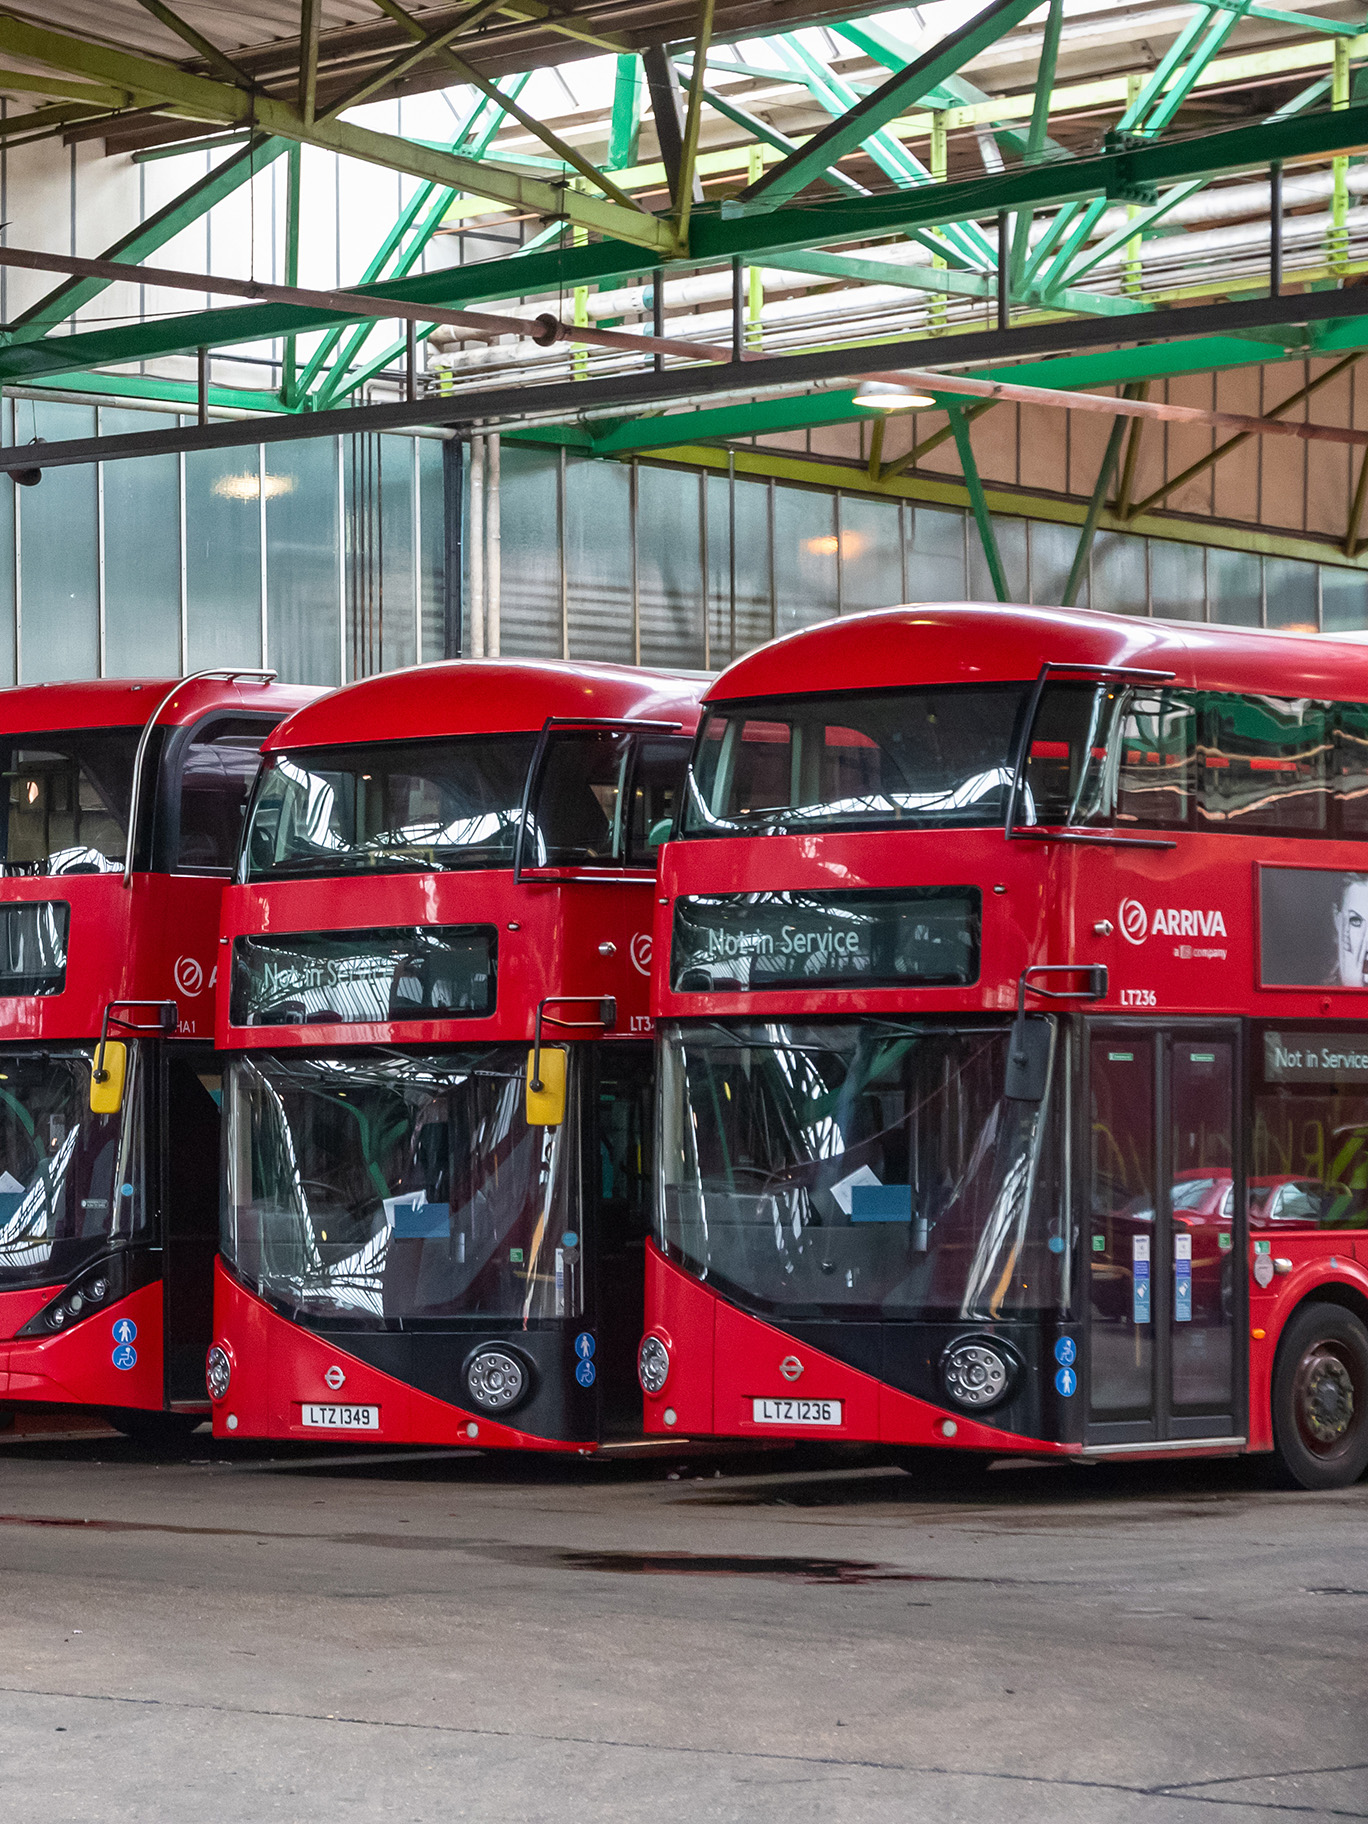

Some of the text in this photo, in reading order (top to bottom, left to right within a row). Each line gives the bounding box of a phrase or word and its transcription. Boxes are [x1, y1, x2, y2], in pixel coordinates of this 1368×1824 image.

[1152, 909, 1227, 937] ARRIVA
[709, 925, 859, 955] Not in Service
[1120, 989, 1157, 1006] LT236
[1275, 1047, 1368, 1069] Not in Service
[310, 1407, 370, 1425] LTZ 1349
[764, 1401, 831, 1420] LTZ 1236
